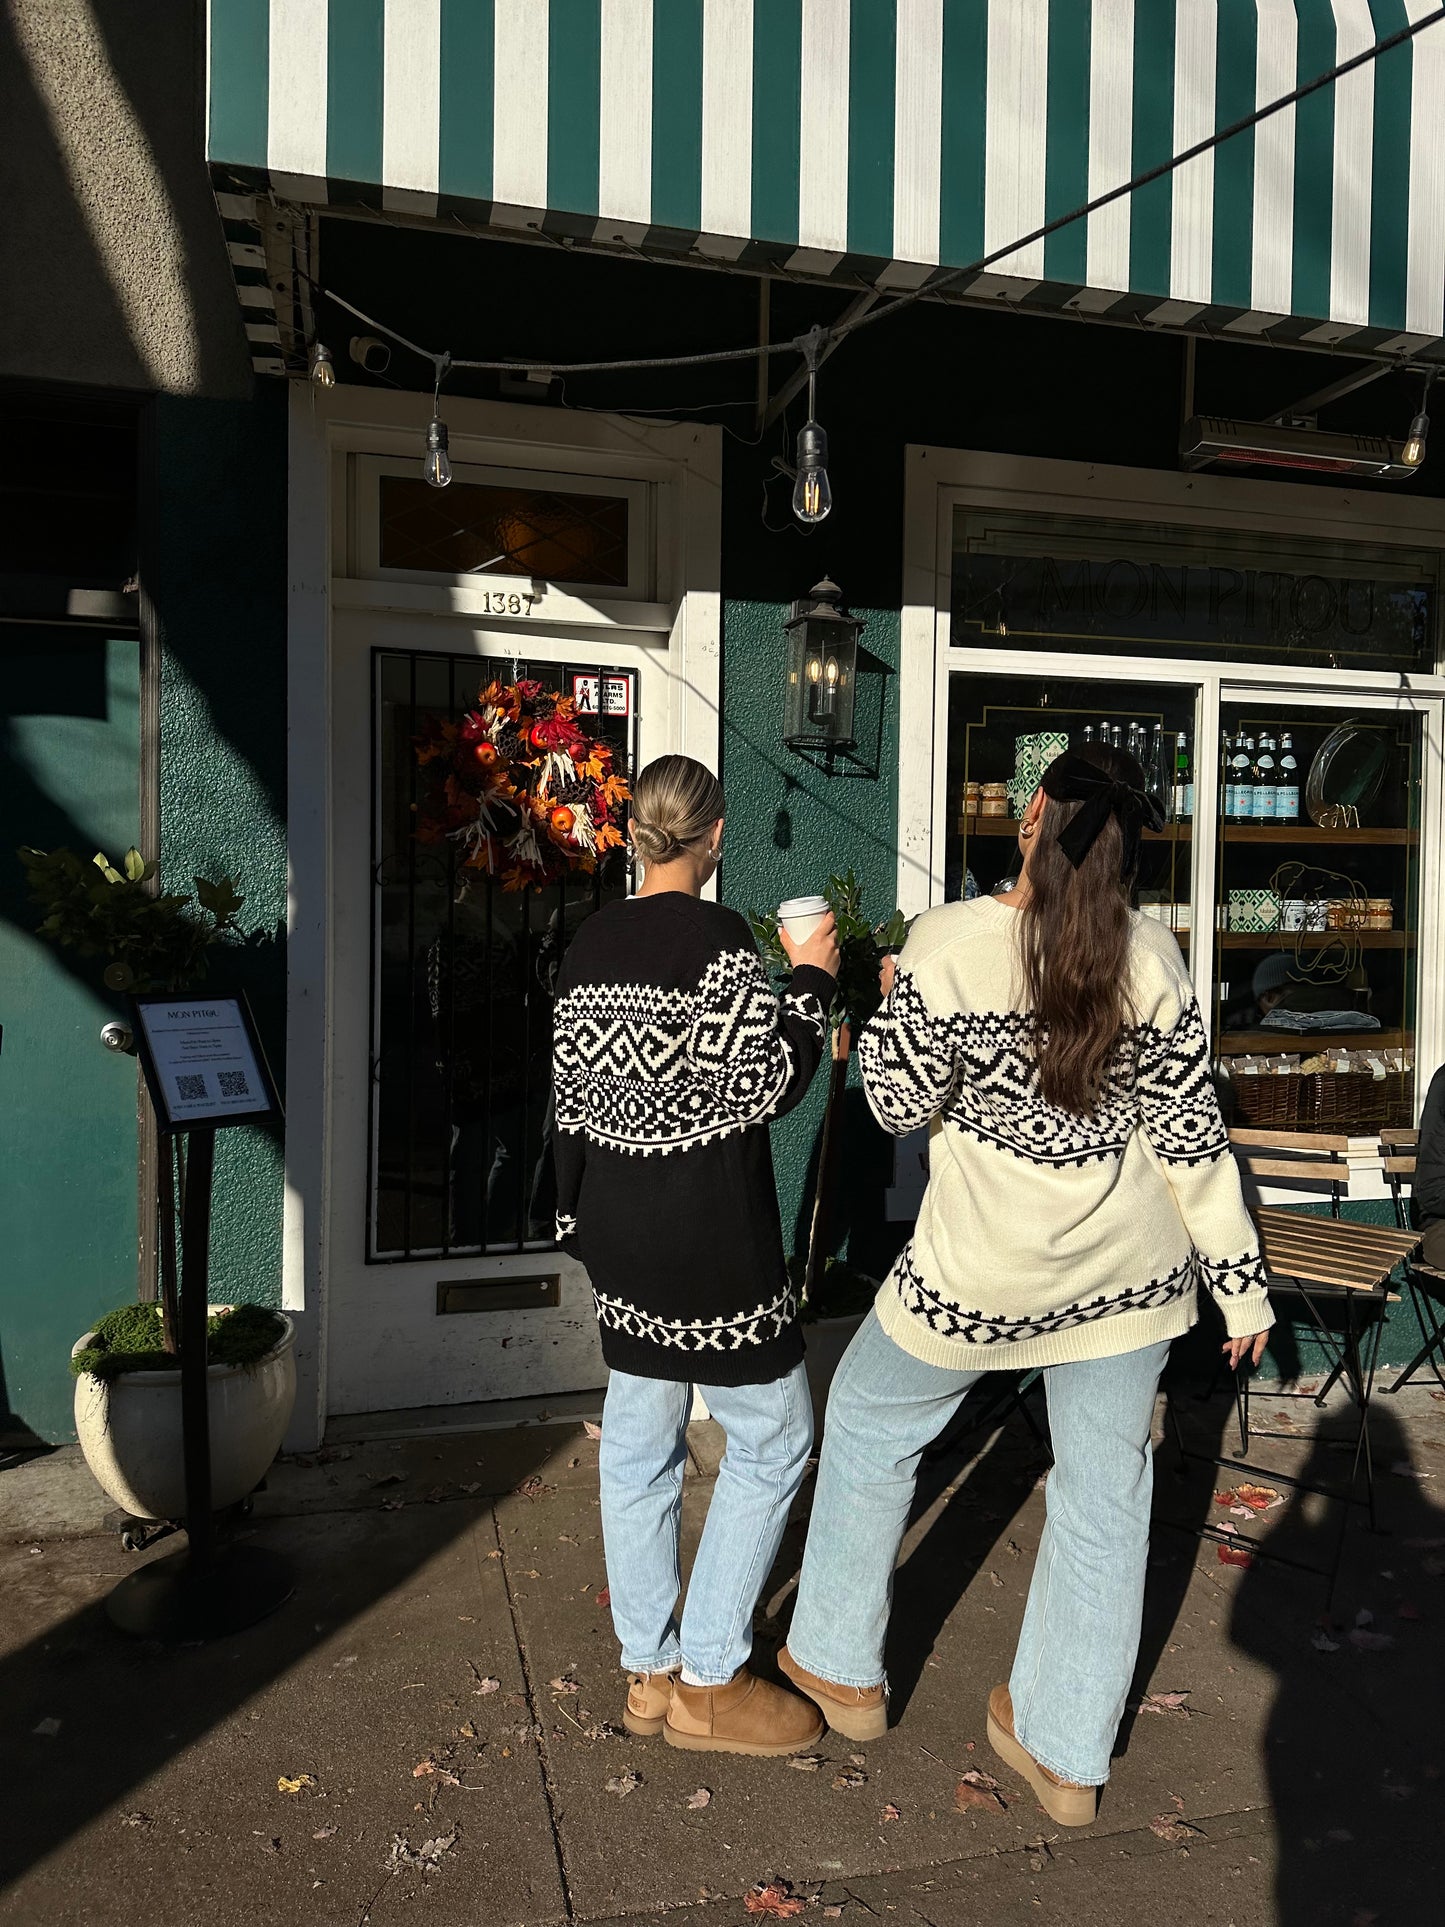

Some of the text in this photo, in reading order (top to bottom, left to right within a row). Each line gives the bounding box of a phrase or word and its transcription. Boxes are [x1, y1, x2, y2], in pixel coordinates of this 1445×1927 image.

[483, 591, 535, 616] 1387
[1040, 556, 1375, 635] MON PITOU
[168, 1010, 191, 1019] MON
